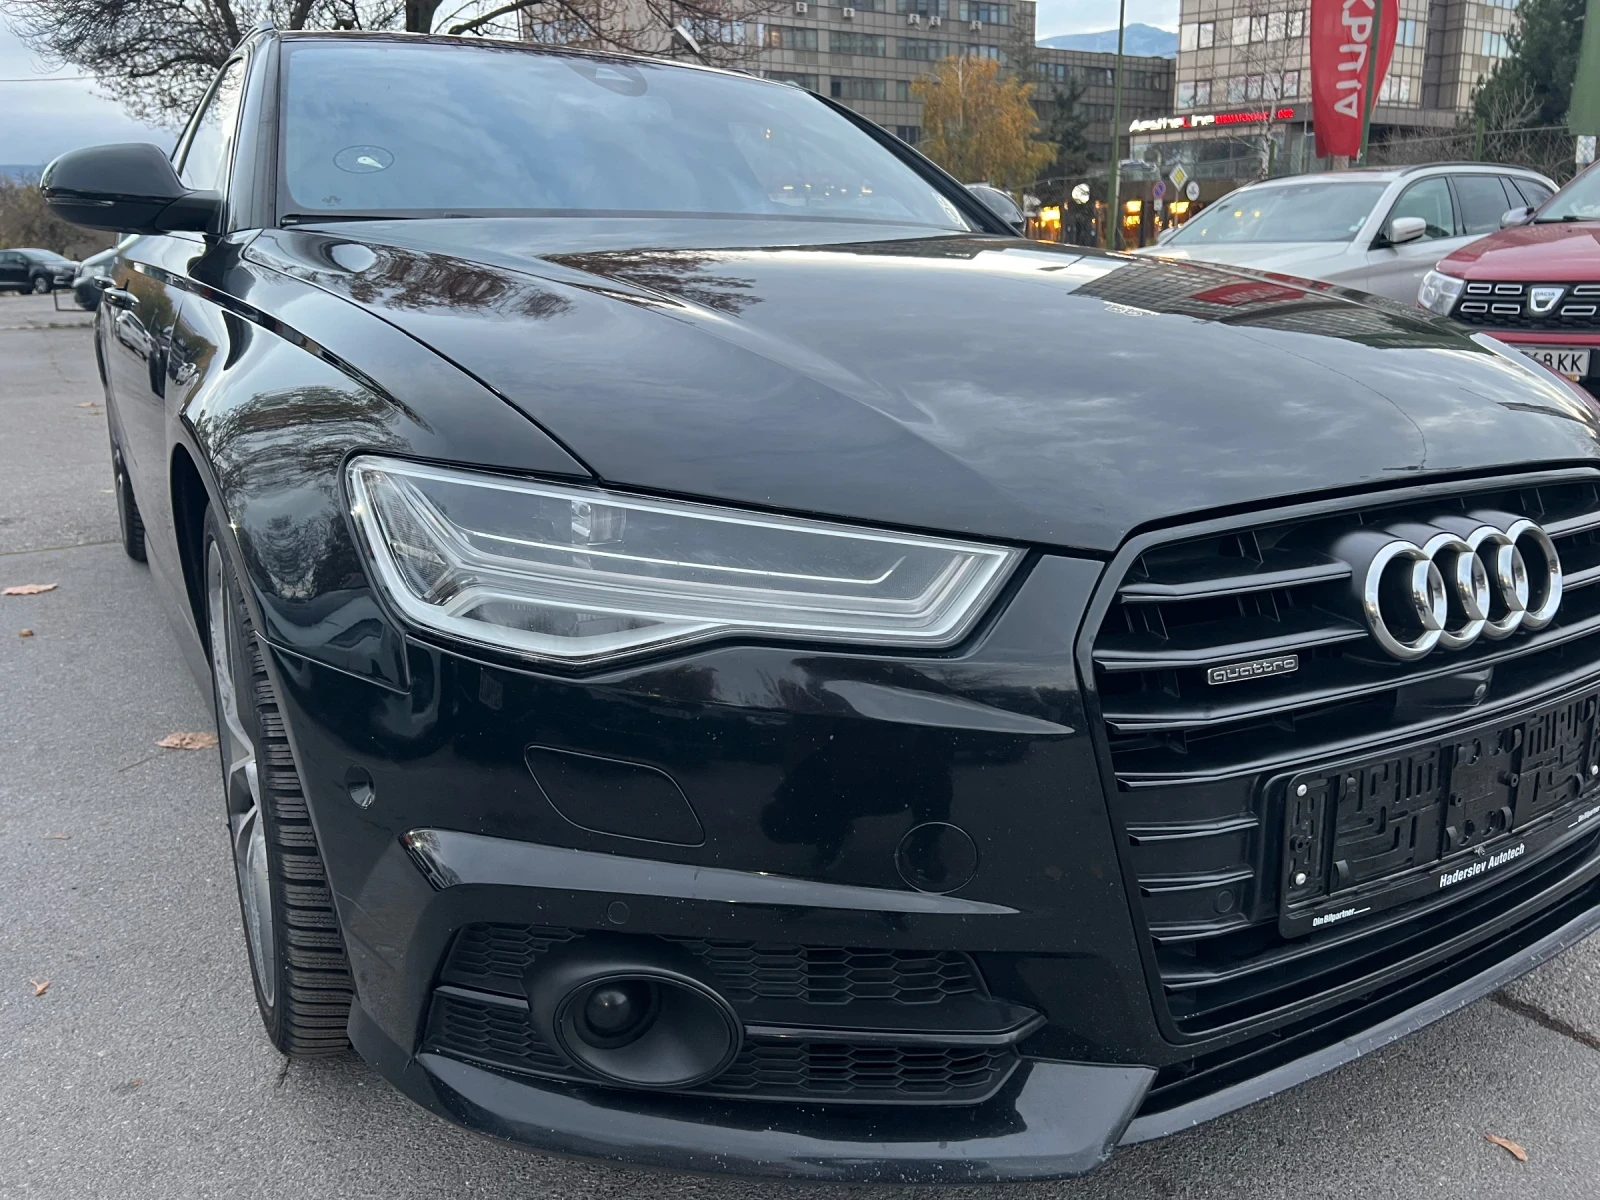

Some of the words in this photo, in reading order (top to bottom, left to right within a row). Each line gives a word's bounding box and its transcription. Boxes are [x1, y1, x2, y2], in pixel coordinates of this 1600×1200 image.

[1213, 659, 1296, 682] quattro
[1439, 860, 1487, 888] Haderslev
[1487, 842, 1525, 870] Autotech
